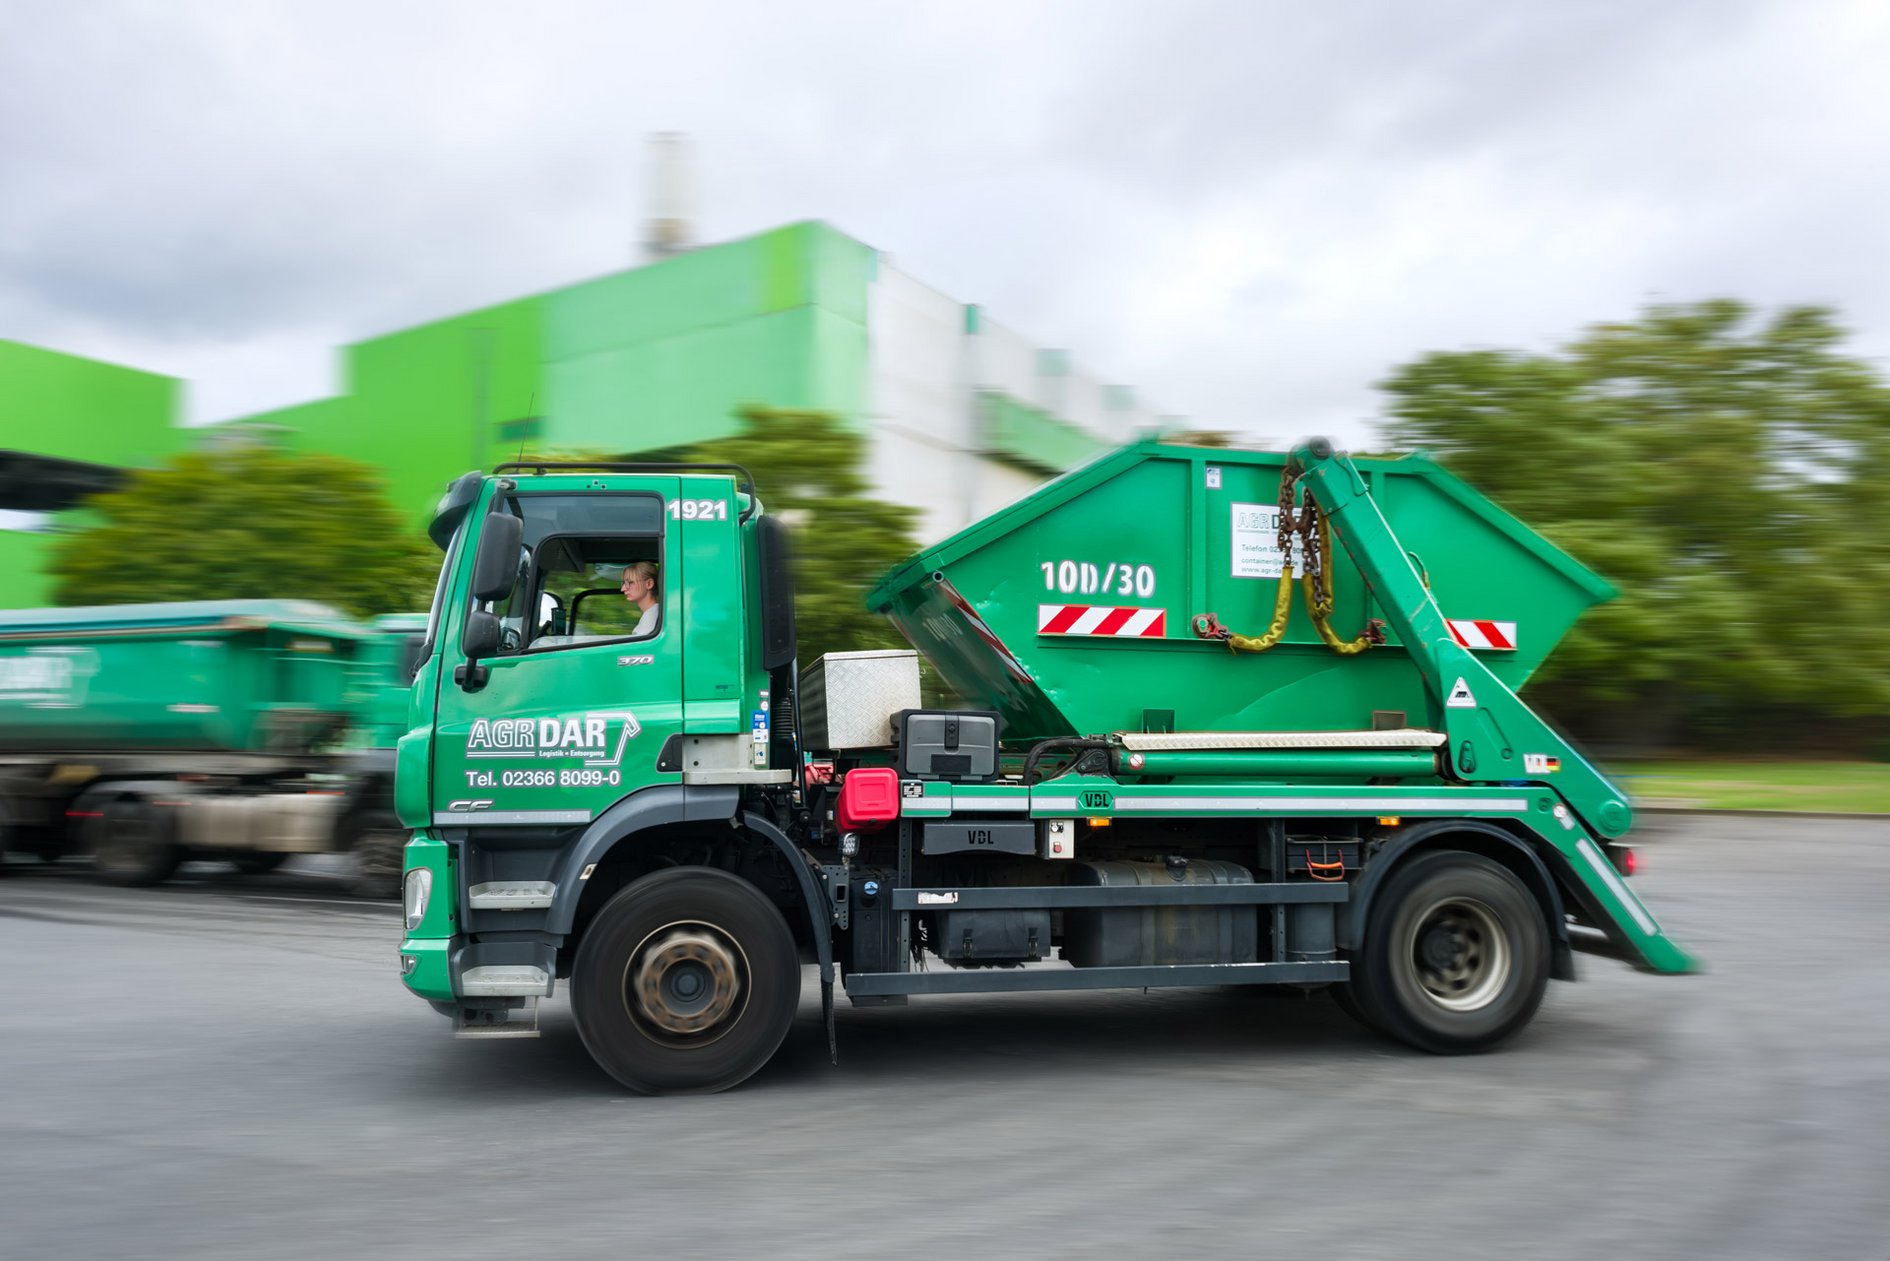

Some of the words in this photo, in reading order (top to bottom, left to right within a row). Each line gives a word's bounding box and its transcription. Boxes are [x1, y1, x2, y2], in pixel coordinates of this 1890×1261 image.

[668, 500, 726, 519] 1921
[1242, 544, 1267, 552] Telefon
[1041, 560, 1155, 598] 10D/30
[619, 656, 653, 666] 370
[539, 750, 564, 759] Logistik
[570, 750, 605, 758] Entsorgung
[466, 771, 497, 787] Tel.
[502, 771, 556, 786] 02366
[560, 770, 620, 785] 8099-0
[448, 800, 493, 812] CF
[1085, 793, 1109, 808] VDL
[967, 830, 994, 845] VDL
